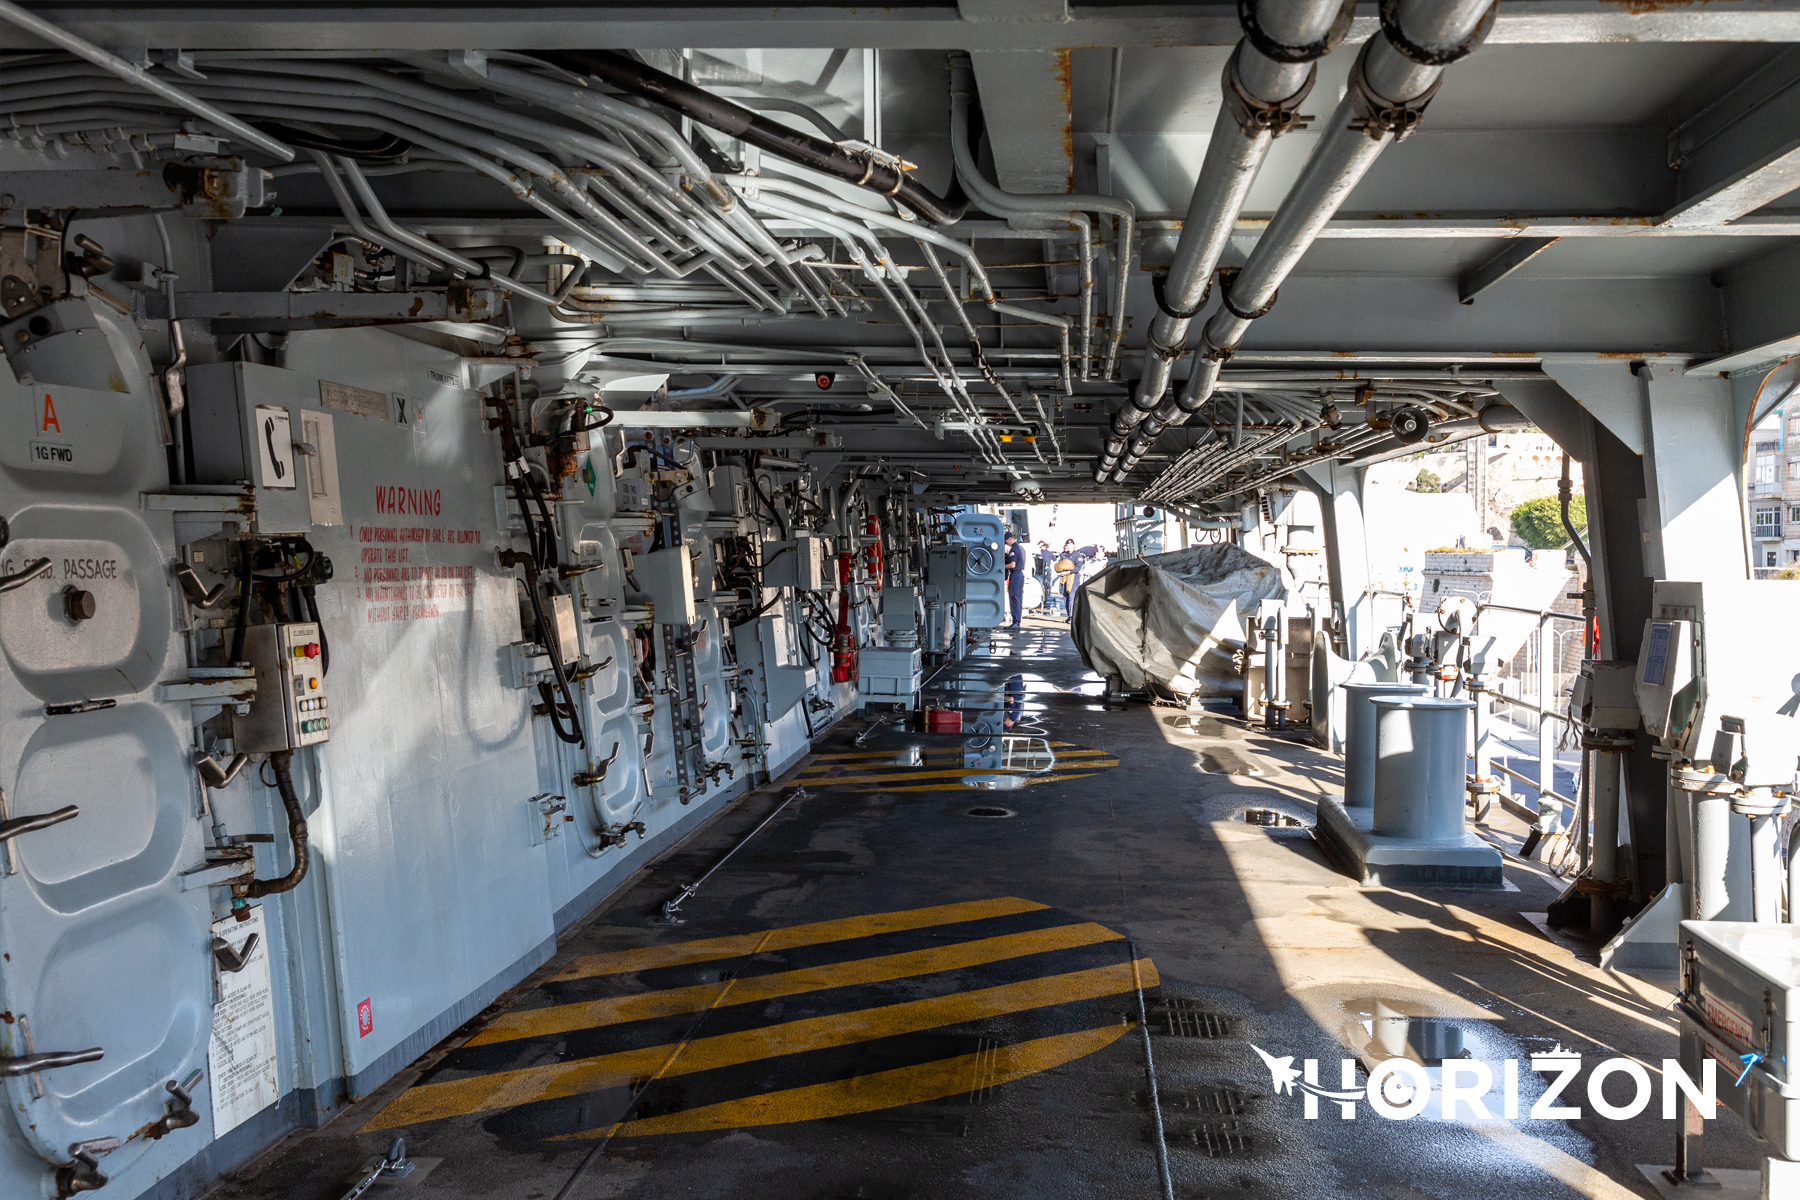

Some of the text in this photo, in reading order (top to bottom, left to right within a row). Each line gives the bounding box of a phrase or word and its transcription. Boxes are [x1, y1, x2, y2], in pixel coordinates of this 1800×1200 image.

[43, 394, 61, 433] A
[397, 398, 407, 424] X
[418, 409, 423, 422] A
[36, 446, 72, 462] 1G FWD
[376, 485, 441, 516] WARNING
[361, 547, 382, 563] OPERATE
[385, 547, 396, 563] THIS
[63, 559, 117, 579] PASSAGE
[1707, 1002, 1750, 1047] EMERGENCY
